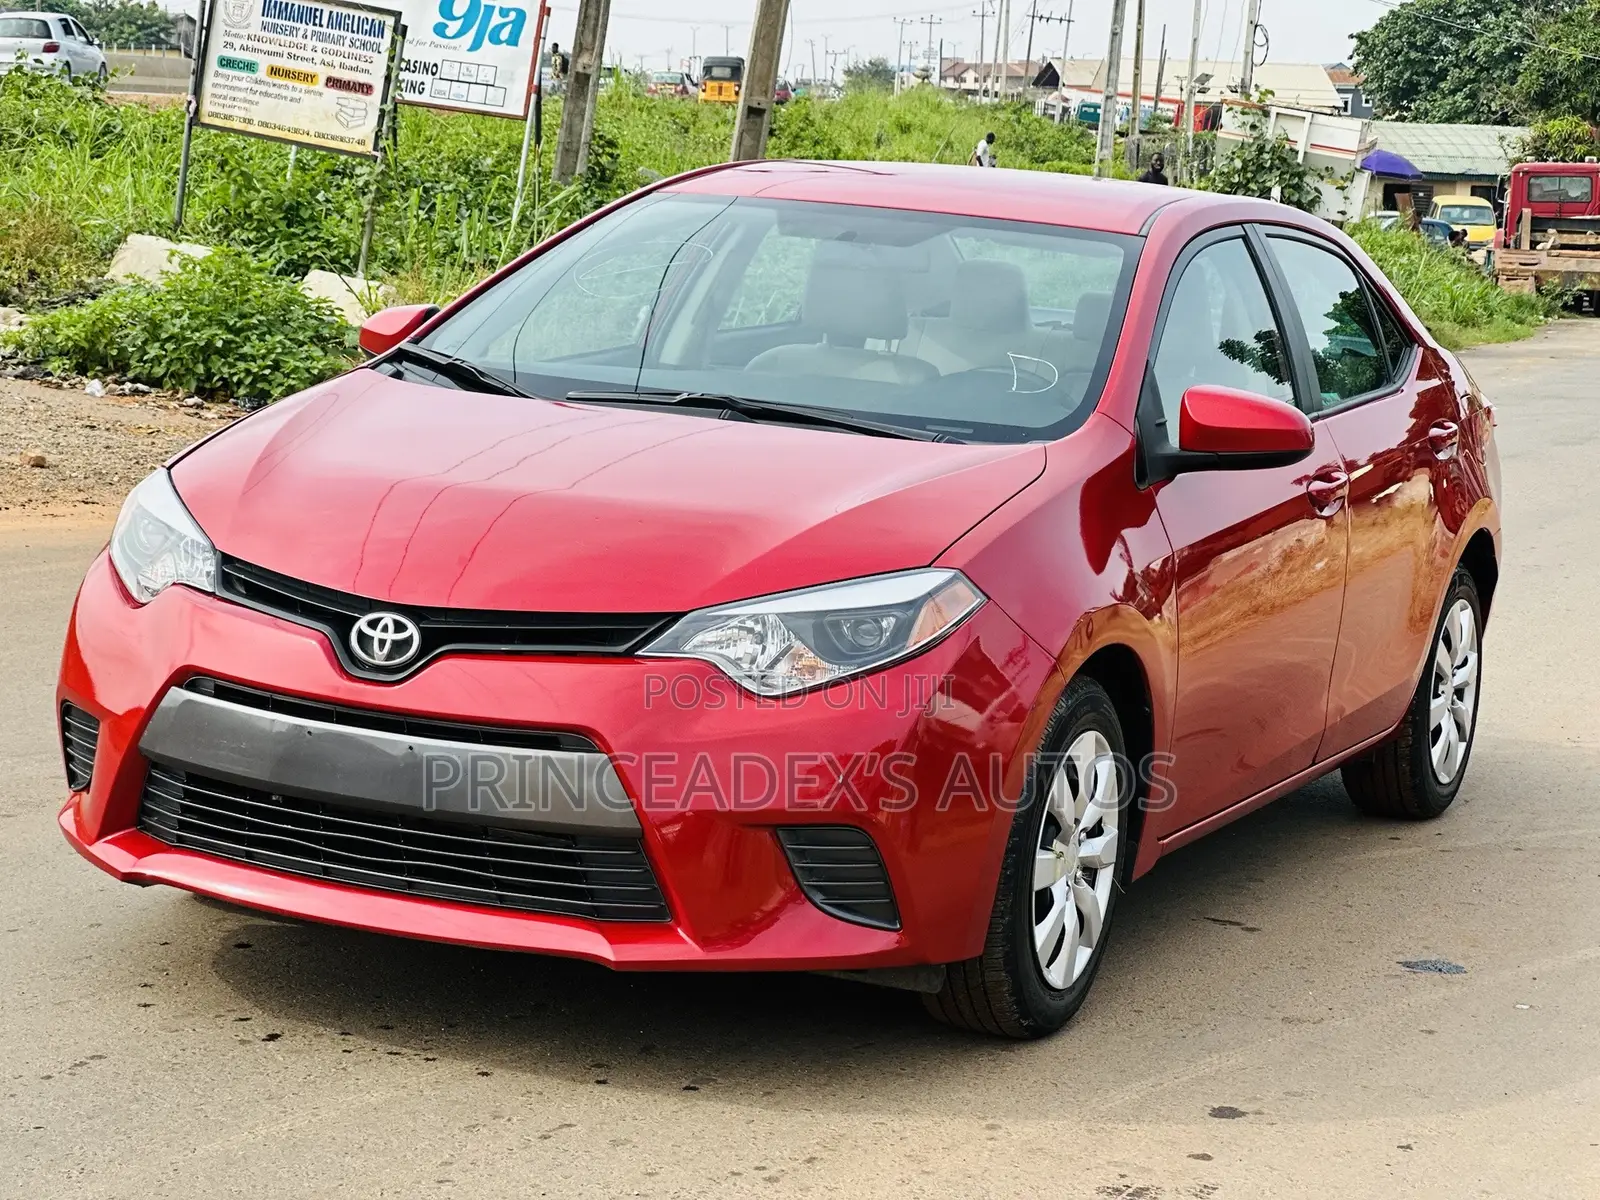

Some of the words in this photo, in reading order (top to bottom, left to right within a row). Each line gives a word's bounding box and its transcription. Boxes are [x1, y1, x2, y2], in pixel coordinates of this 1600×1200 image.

[261, 0, 324, 28] IMMANUEL
[326, 10, 386, 39] ANGLICAN
[246, 33, 309, 51] KNOWLEDGE
[311, 44, 318, 53] &
[320, 46, 374, 64] GODLINESS
[260, 20, 300, 38] NURSERY
[301, 28, 308, 40] &
[310, 29, 347, 48] PRIMARY
[348, 36, 382, 54] SCHOOL
[223, 40, 237, 52] 29,
[239, 43, 284, 58] Akinwumi
[286, 51, 317, 66] Street,
[320, 58, 336, 69] Asi,
[339, 61, 372, 75] Ibadan.
[213, 70, 230, 82] Bring
[231, 74, 244, 83] your
[219, 57, 256, 73] CRECHE
[270, 66, 317, 84] NURSERY
[325, 76, 374, 95] PRIMARY
